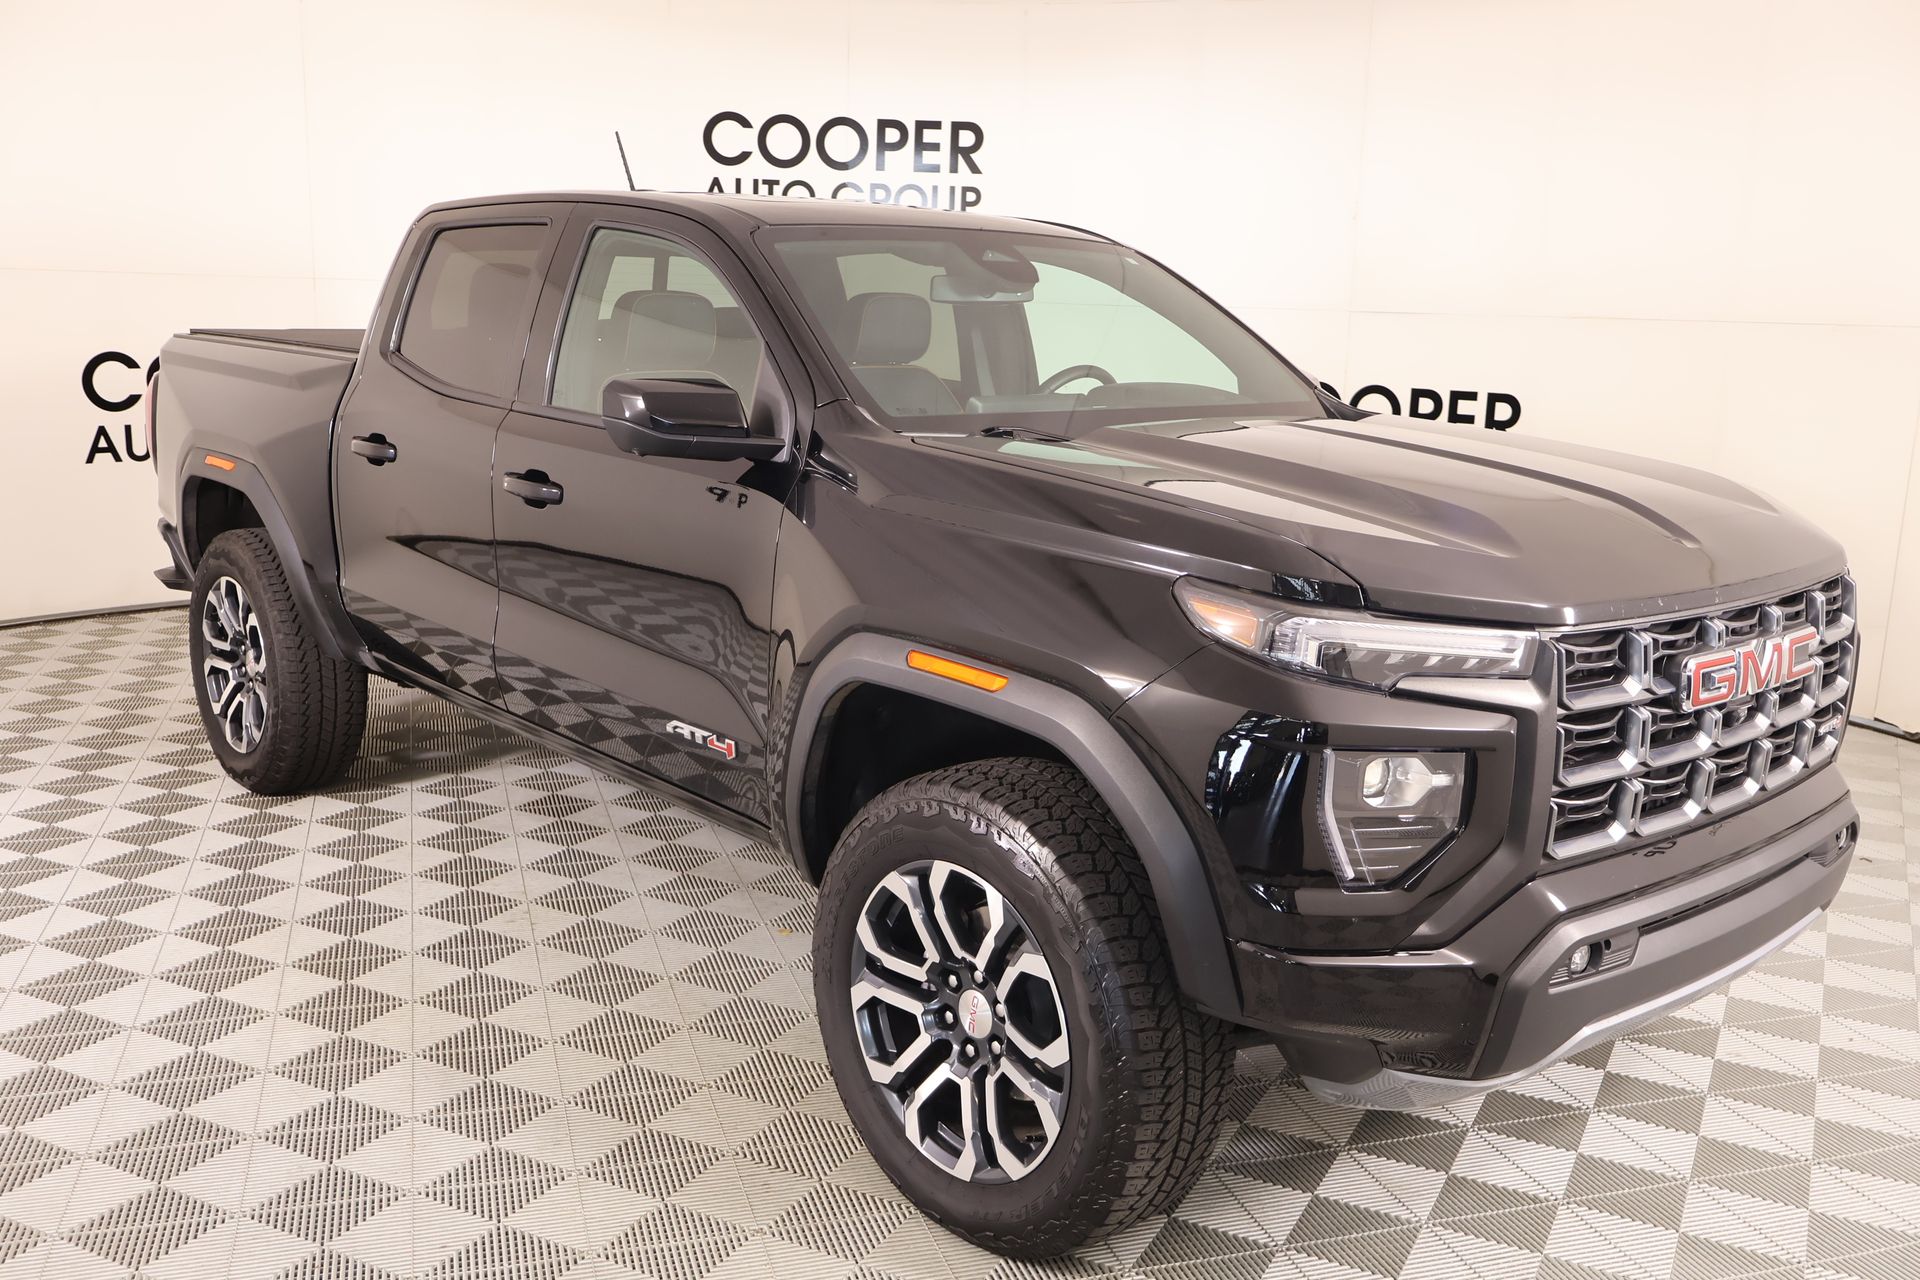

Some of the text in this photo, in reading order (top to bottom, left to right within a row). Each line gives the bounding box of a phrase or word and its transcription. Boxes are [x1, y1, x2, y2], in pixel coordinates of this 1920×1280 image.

[703, 111, 984, 174] COOPER
[1685, 626, 1820, 711] GMC
[666, 719, 736, 760] AT4
[968, 995, 980, 1034] GMC
